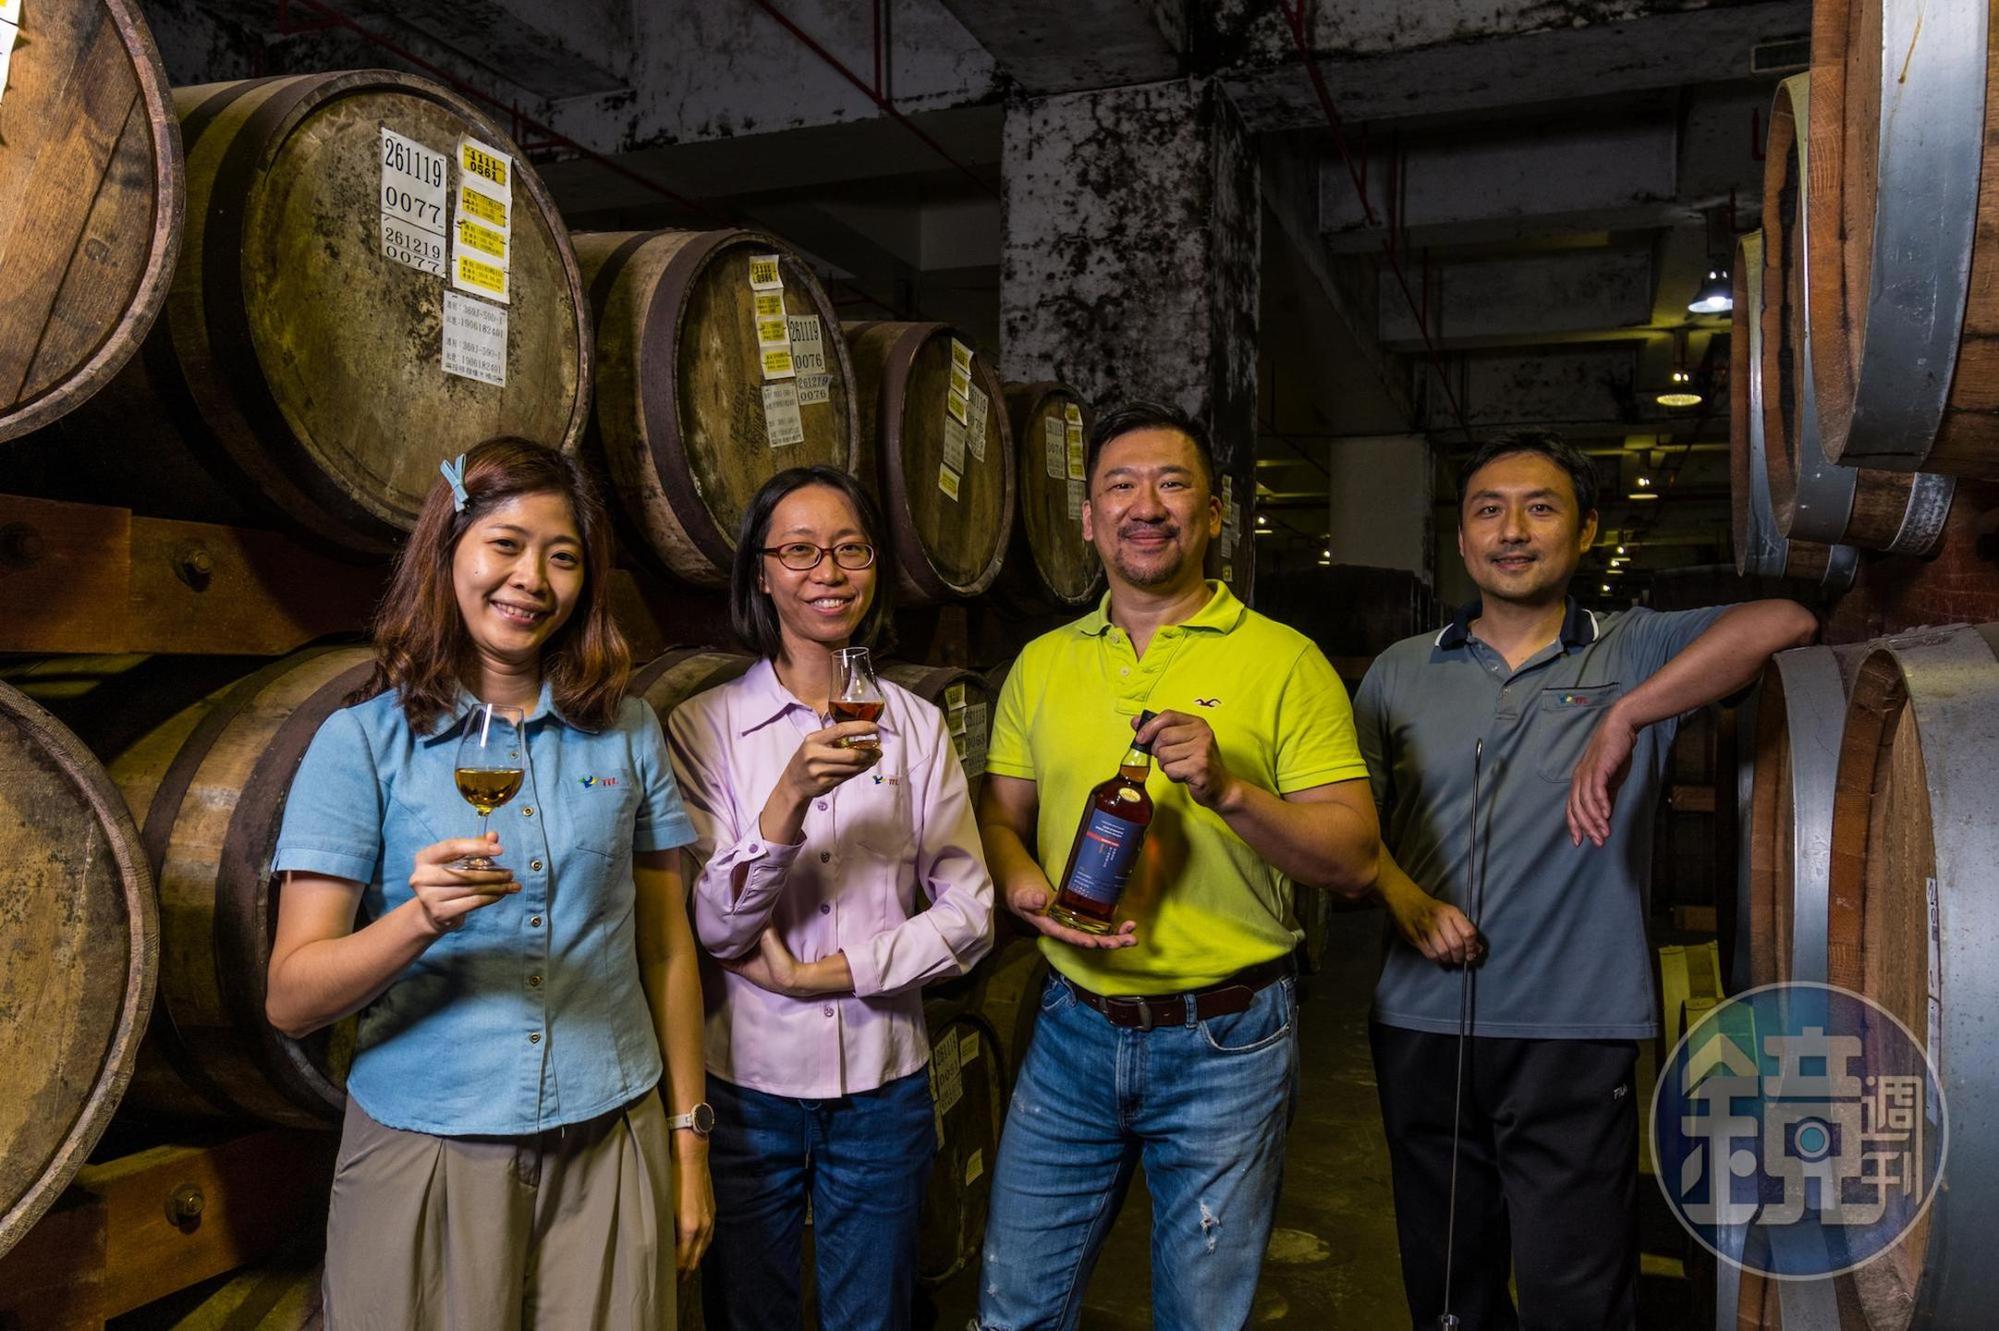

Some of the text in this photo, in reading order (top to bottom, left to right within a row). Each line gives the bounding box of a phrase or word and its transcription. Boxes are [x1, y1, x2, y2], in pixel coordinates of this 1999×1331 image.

[385, 138, 441, 188] 261119
[470, 151, 497, 170] 1111
[470, 162, 497, 182] 0561
[386, 186, 441, 224] 0077
[385, 227, 440, 259] 261219
[386, 245, 440, 273] 0077
[789, 321, 819, 342] 261119
[795, 353, 822, 369] 0076
[801, 390, 827, 401] 0076
